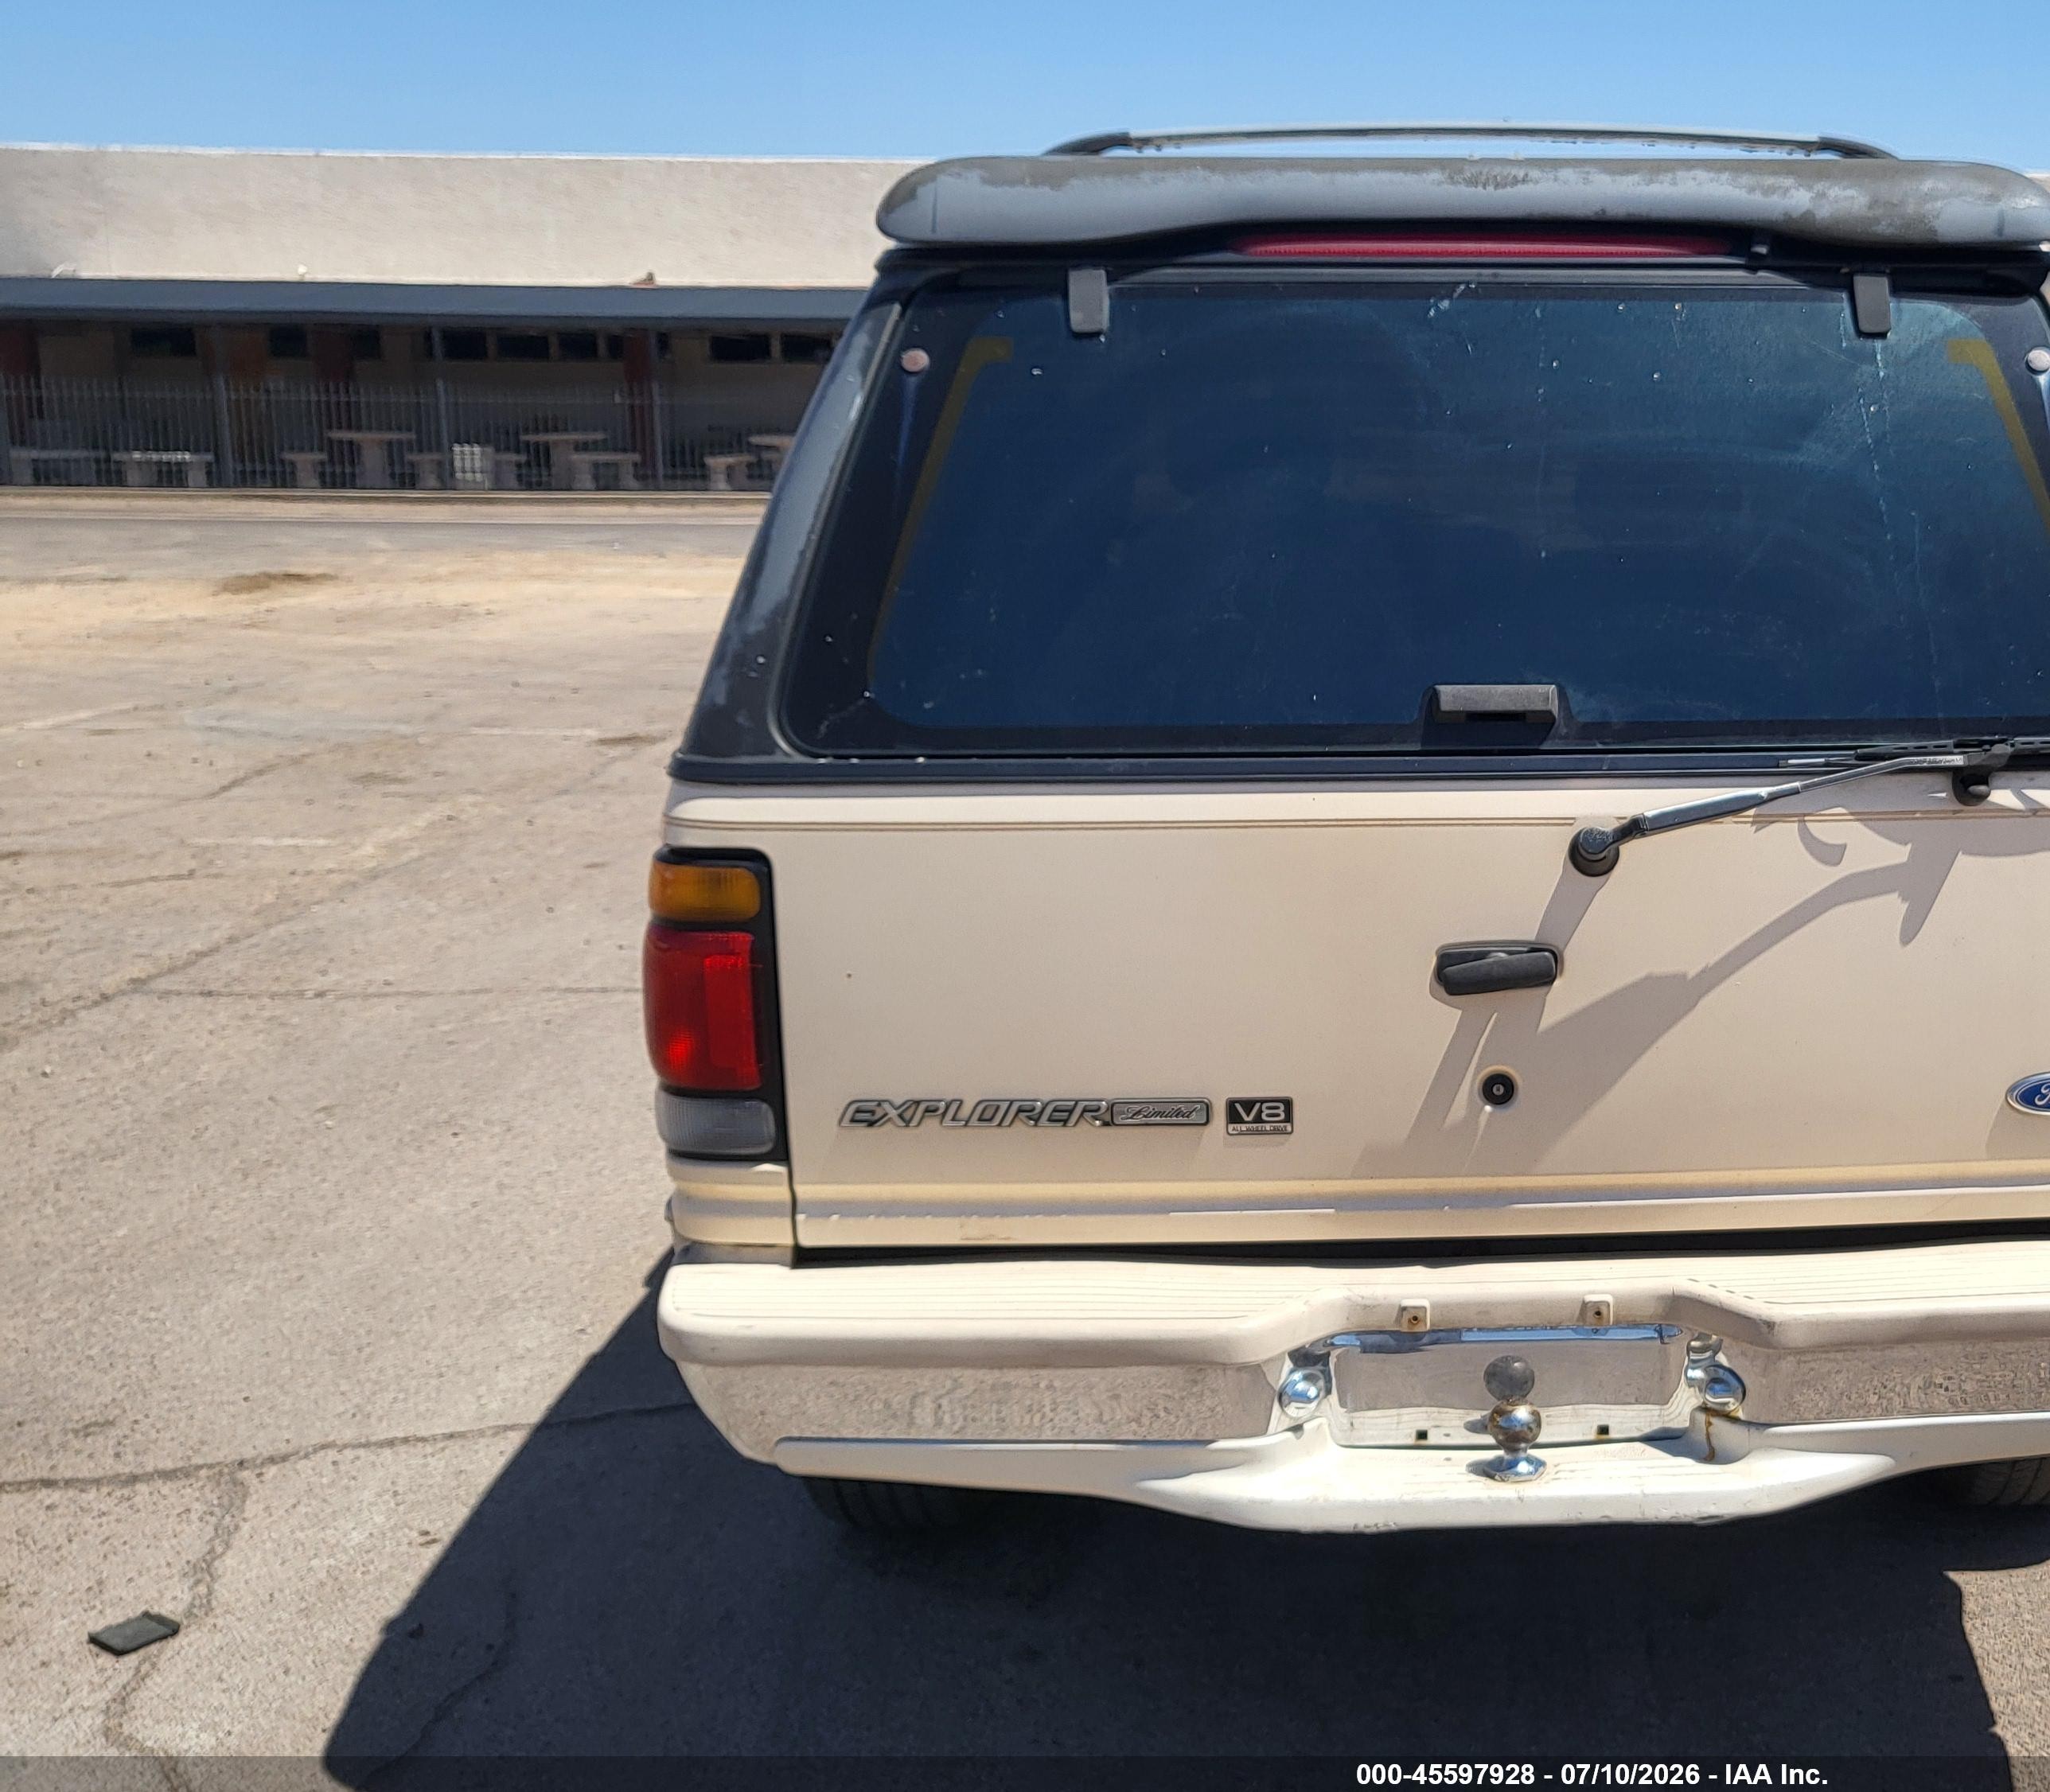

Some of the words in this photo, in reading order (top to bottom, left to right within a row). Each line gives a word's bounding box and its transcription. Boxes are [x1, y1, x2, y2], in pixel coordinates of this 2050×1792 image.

[839, 1099, 1109, 1127] EXPLORER
[1120, 1104, 1200, 1121] Limited
[1234, 1102, 1285, 1121] V8
